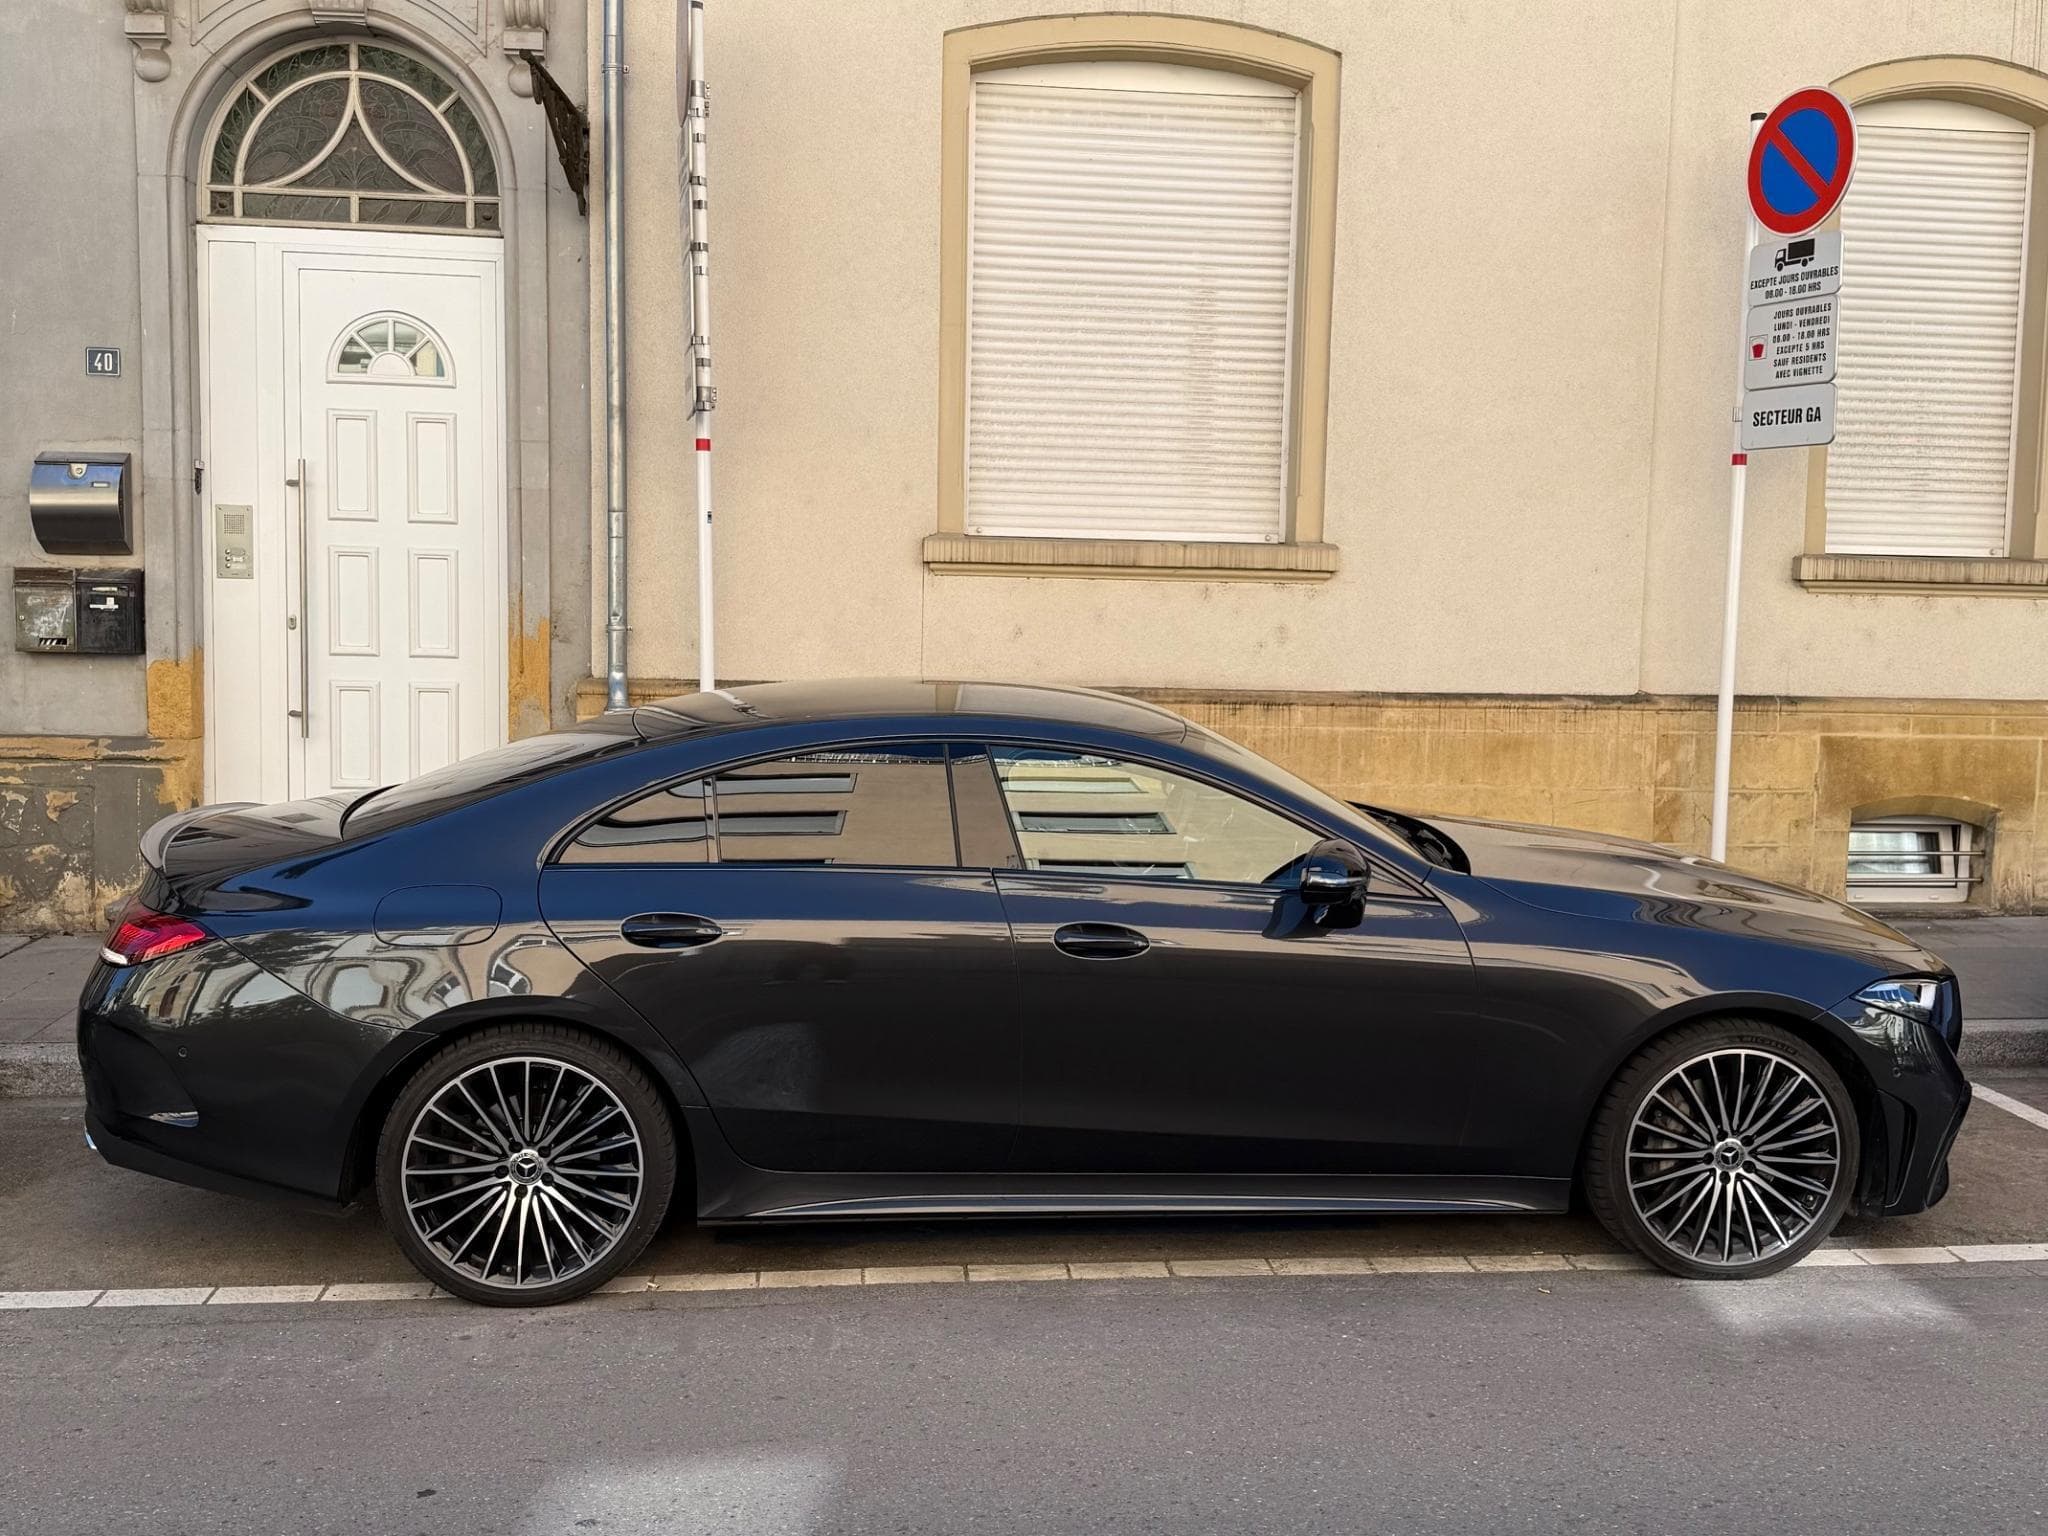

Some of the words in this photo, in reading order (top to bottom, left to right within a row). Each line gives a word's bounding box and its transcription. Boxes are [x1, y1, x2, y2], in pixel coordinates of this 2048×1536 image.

[1750, 277, 1777, 290] EXCEPTE
[1778, 273, 1799, 285] JOURS
[1800, 266, 1839, 281] OUVRABLES
[1807, 281, 1821, 292] HRS
[1773, 309, 1794, 319] JOURS
[1795, 303, 1832, 316] OUVRABLES
[1773, 321, 1793, 331] LUNDI
[1799, 316, 1830, 328] VENDREDI
[1816, 328, 1830, 337] HRS
[1776, 344, 1803, 355] EXCEPTE
[1811, 341, 1825, 350] HRS
[94, 353, 113, 371] 40
[1773, 358, 1789, 367] SAUF
[1791, 353, 1827, 365] RESIDENTS
[1775, 370, 1791, 379] AVEC
[1793, 365, 1823, 377] VIGNETTE
[1752, 408, 1803, 427] SECTEUR
[1806, 407, 1821, 422] GA
